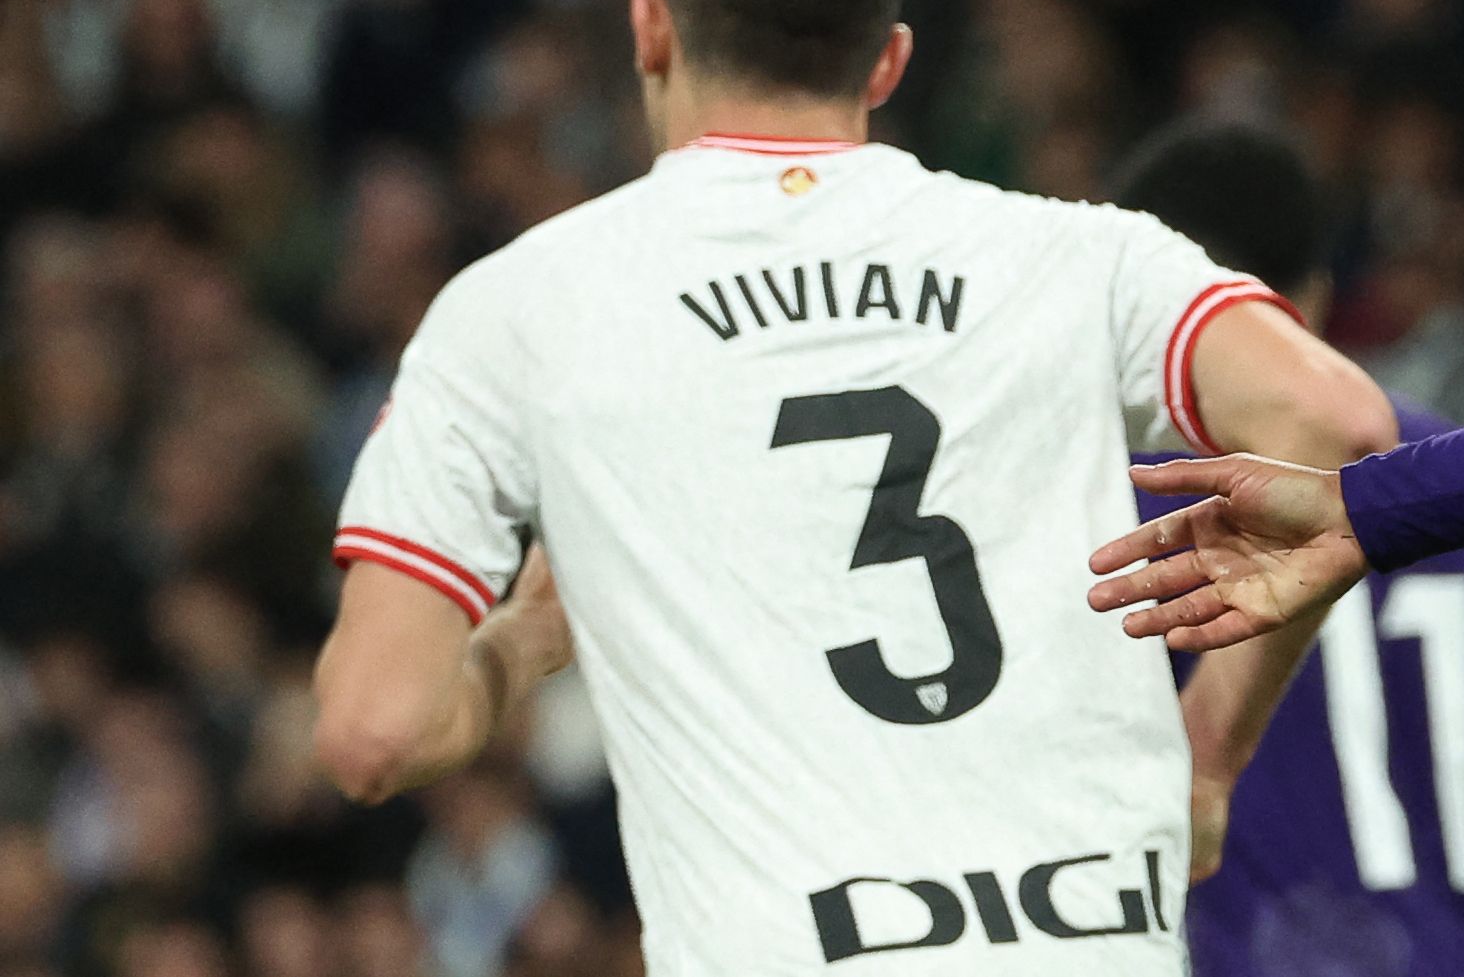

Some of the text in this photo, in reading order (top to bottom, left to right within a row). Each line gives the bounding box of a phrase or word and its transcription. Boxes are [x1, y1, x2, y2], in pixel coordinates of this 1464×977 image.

[679, 261, 964, 341] VIVIAN
[770, 384, 1004, 725] 3
[808, 850, 1169, 963] DIGI
